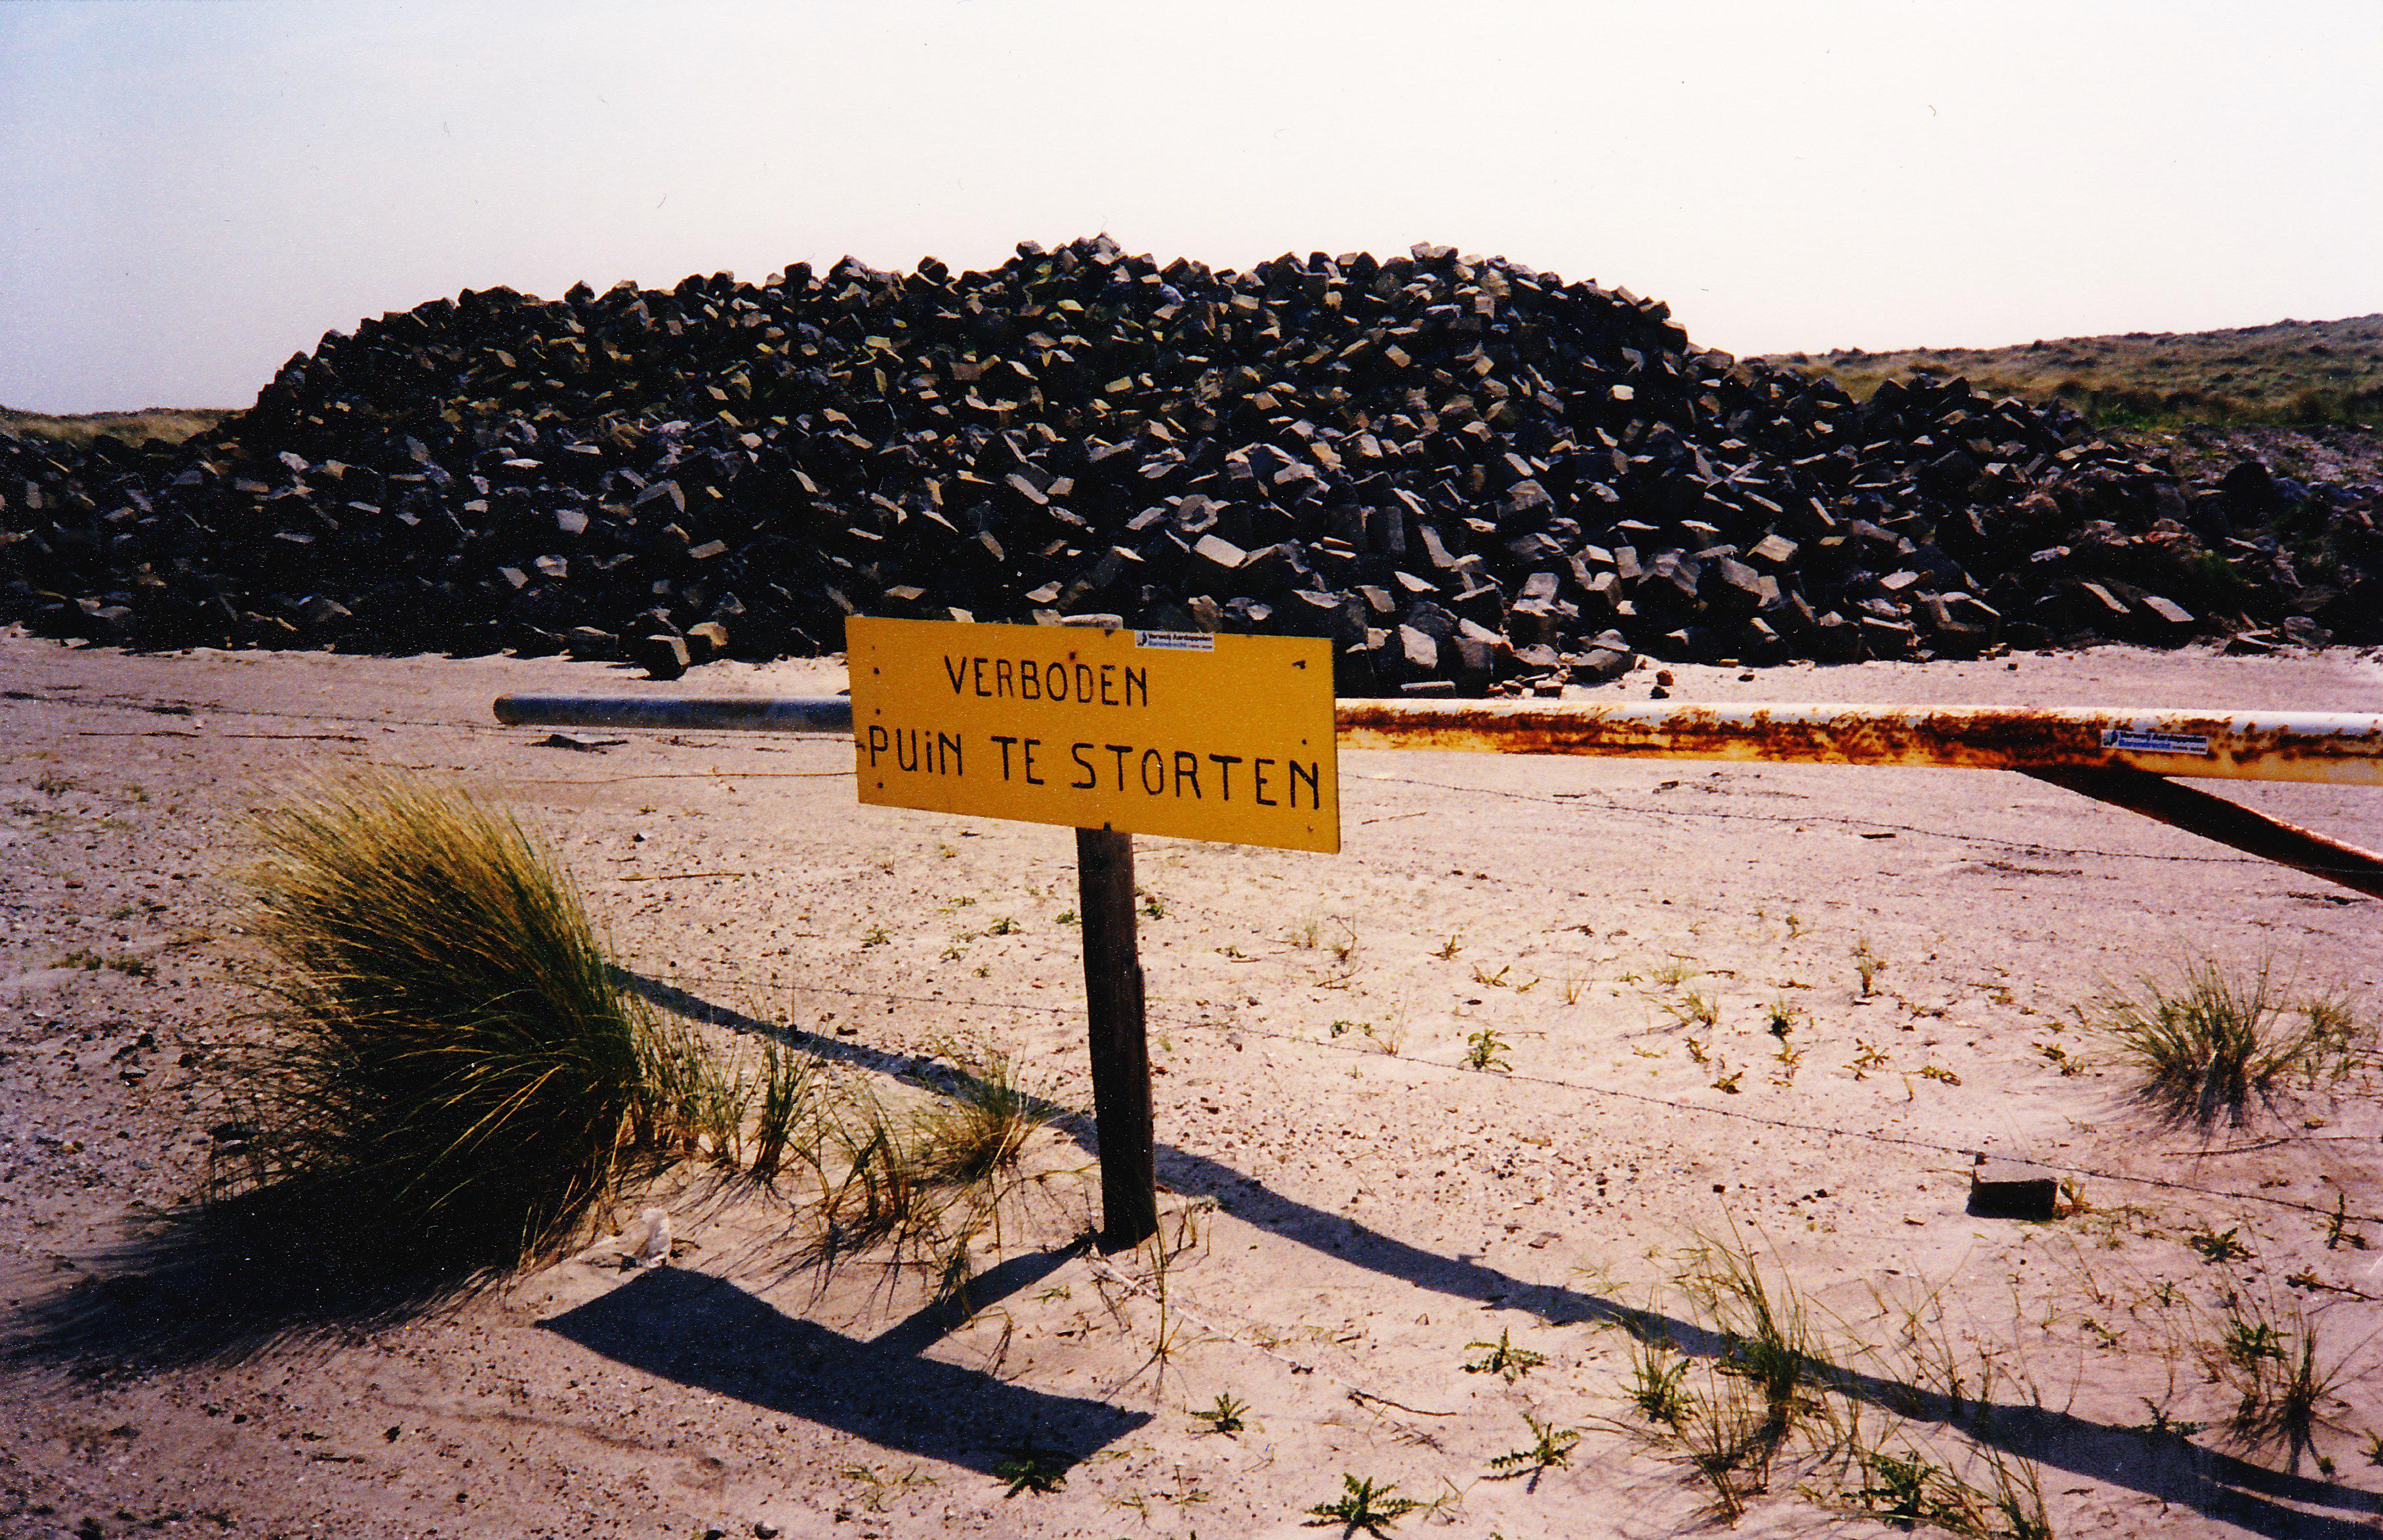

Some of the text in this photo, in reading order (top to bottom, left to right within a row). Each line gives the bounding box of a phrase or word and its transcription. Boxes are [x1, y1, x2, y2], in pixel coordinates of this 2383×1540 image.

[944, 654, 1148, 707] VERBODEN
[990, 735, 1045, 786] TE
[1070, 742, 1320, 810] STORTEN
